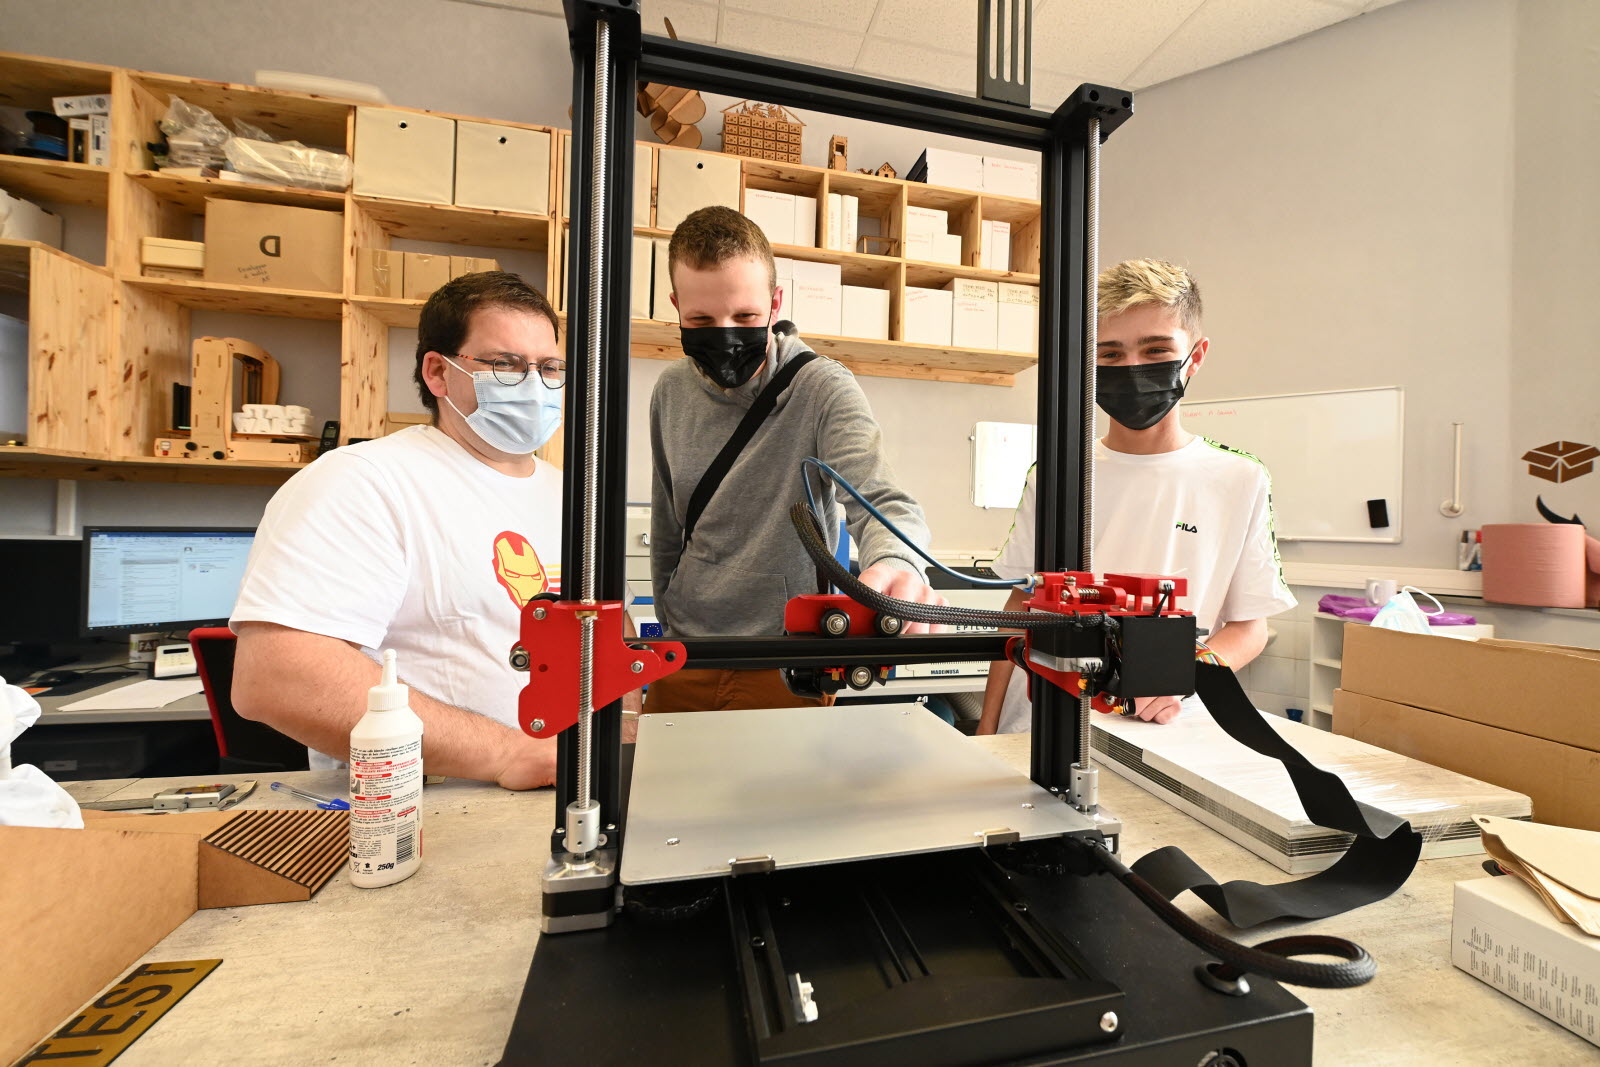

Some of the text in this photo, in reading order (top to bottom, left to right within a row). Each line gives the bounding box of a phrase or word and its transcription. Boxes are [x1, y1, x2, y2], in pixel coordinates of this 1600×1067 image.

[1176, 522, 1197, 533] FILA
[377, 862, 395, 871] 250g
[9, 963, 196, 1067] TEST
